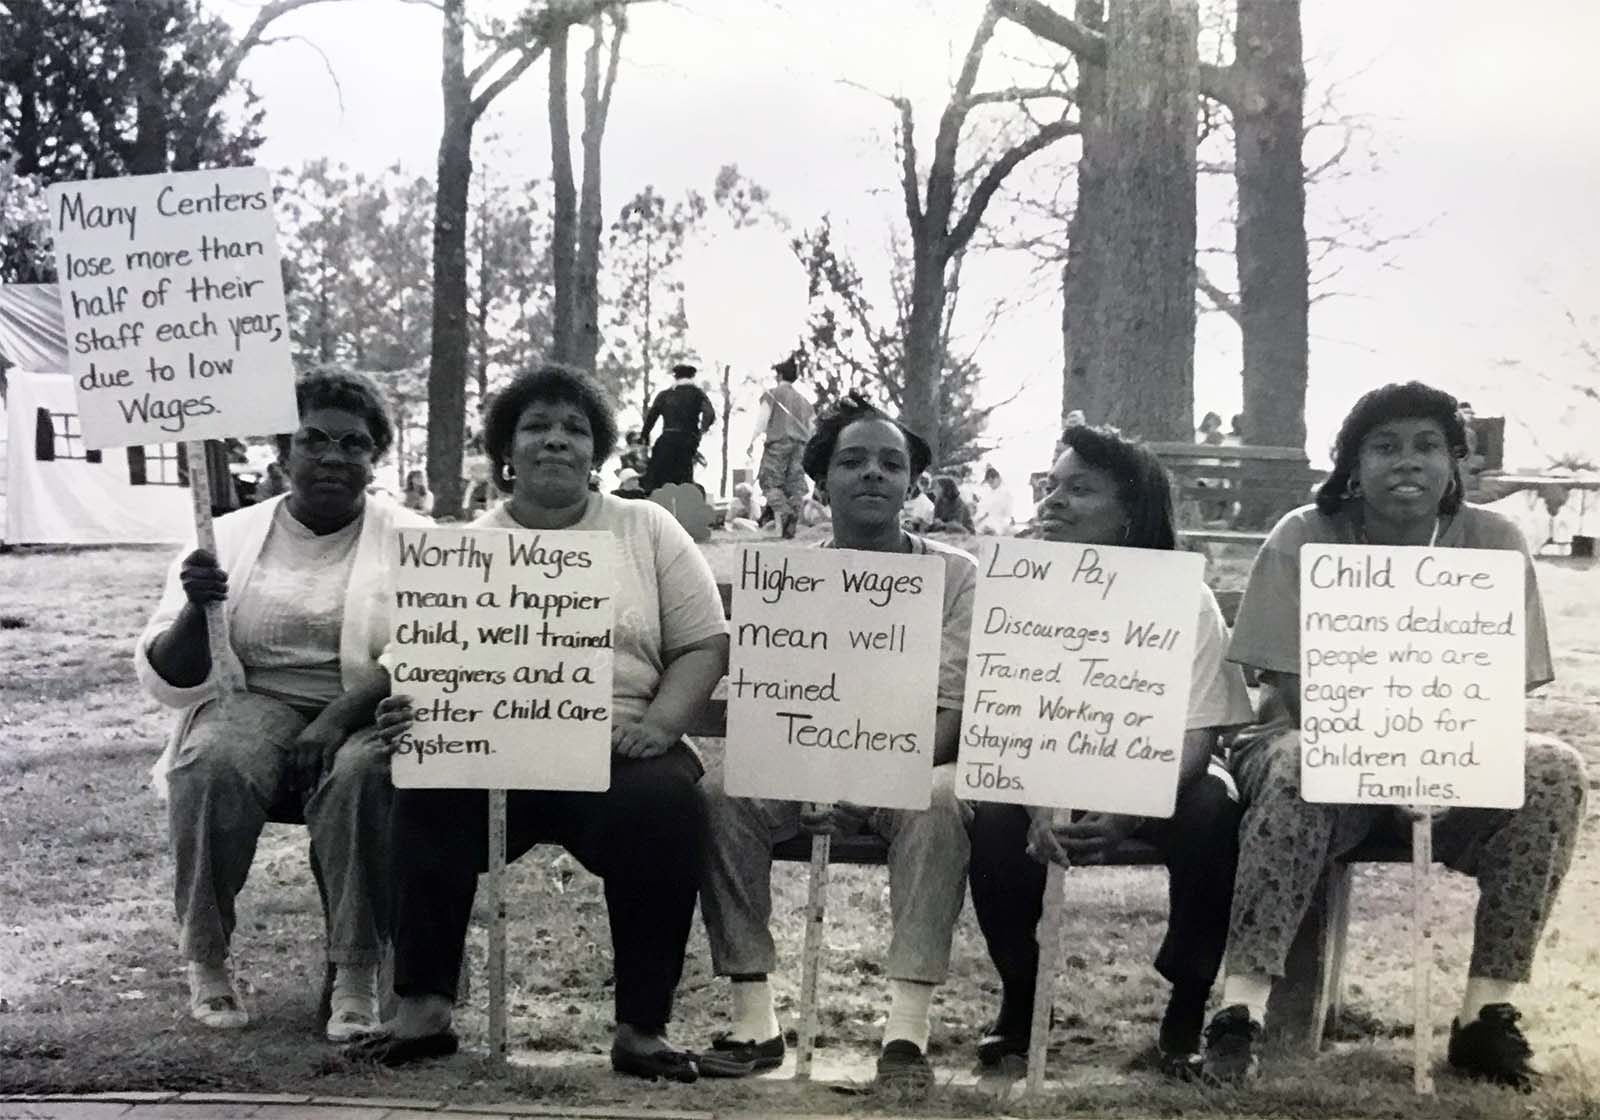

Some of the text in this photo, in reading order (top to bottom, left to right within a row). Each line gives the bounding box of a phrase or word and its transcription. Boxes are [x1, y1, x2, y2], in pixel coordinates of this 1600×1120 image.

[59, 184, 267, 240] Many Centers
[66, 235, 263, 280] lose more than
[72, 276, 264, 318] half of their
[156, 313, 217, 340] each
[228, 313, 282, 351] year,
[80, 353, 233, 391] due to low
[118, 393, 222, 432] Wages.
[399, 532, 592, 583] Worthy Wages
[986, 543, 1117, 600] Low Pay
[1310, 554, 1495, 590] Child Care
[741, 549, 825, 604] Higher
[396, 584, 609, 619] mean a happier
[478, 624, 528, 645] well
[536, 622, 614, 649] trained
[739, 623, 905, 652] mean well
[984, 606, 1180, 651] Discourages Well
[1306, 606, 1516, 636] means dedicated
[513, 662, 565, 685] and
[572, 667, 595, 684] a
[976, 653, 1165, 696] Trained Teachers
[1306, 643, 1491, 678] people who are
[732, 668, 840, 701] trained
[1304, 676, 1490, 712] eager to do a
[411, 699, 609, 723] etter Child Care
[973, 689, 1153, 735] From Working or
[1304, 707, 1477, 745] good job for
[776, 712, 921, 754] Teachers.
[964, 725, 1176, 762] Staying in Child Care
[1420, 742, 1480, 767] and
[965, 762, 1024, 790] Jobs.
[1357, 772, 1461, 800] Families.
